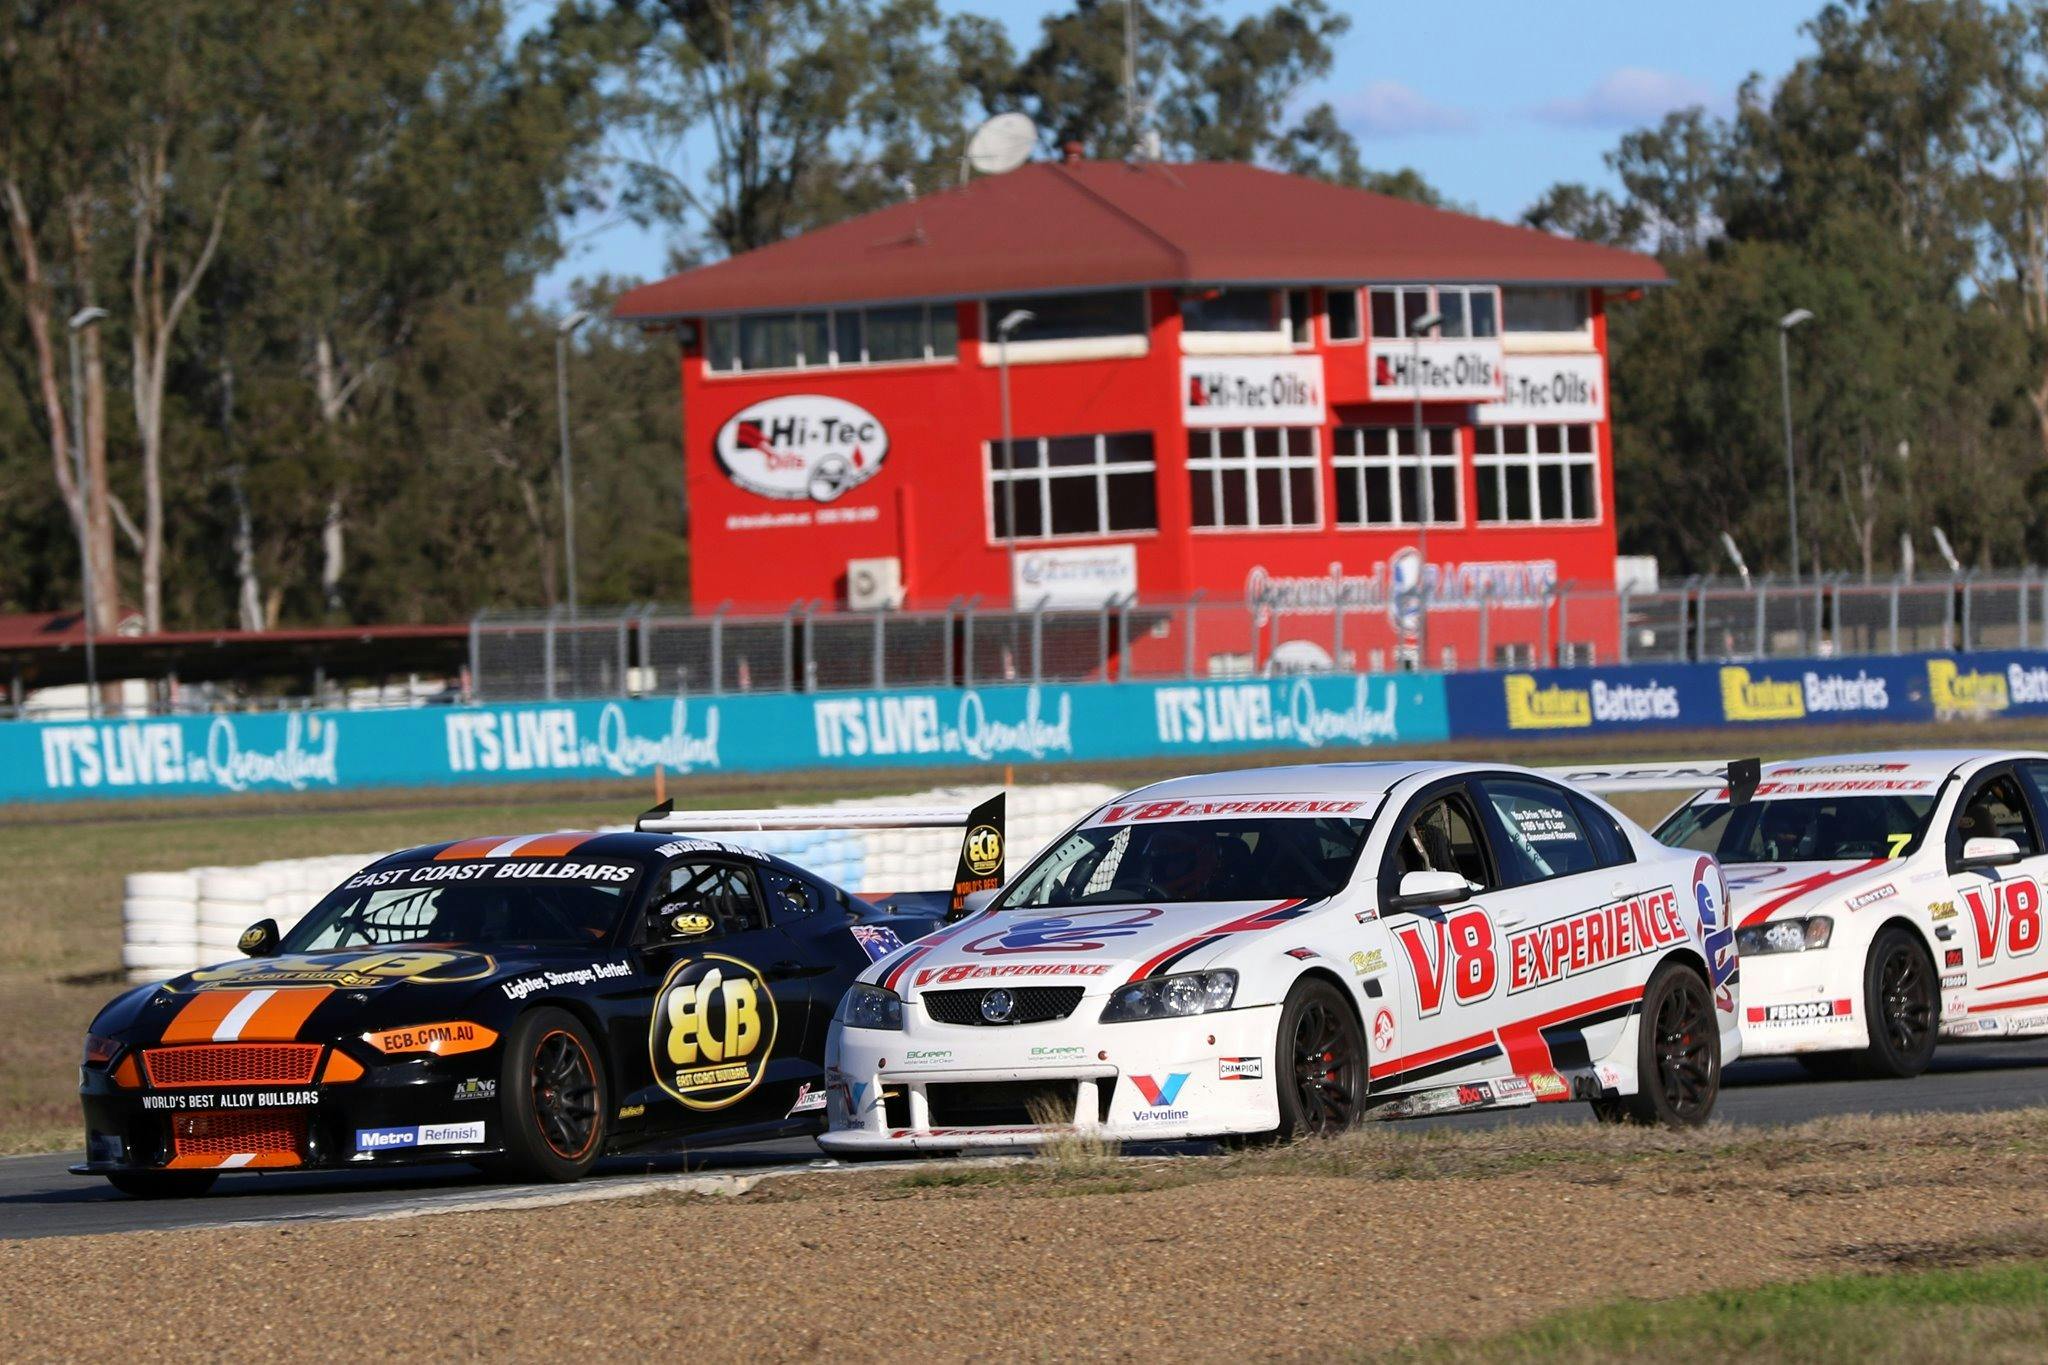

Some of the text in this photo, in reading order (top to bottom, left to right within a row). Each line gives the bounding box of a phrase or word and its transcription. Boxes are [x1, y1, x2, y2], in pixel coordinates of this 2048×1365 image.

[1395, 354, 1490, 386] Hi-Tec Oils
[1209, 372, 1307, 407] Hi-Tec Oils
[1552, 372, 1587, 403] Oils
[771, 416, 875, 446] Hi-Tec
[1591, 679, 1680, 721] Batteries
[1804, 669, 1889, 712] Batteries
[814, 698, 867, 757] IT'S
[867, 695, 941, 754] LIVE!
[959, 685, 1073, 760] Queensland
[1155, 687, 1204, 742] IT'S
[1204, 685, 1274, 742] LIVE!
[1290, 674, 1398, 747] Queensland
[41, 726, 101, 788] IT'S
[101, 723, 185, 785] LIVE!
[207, 713, 338, 791] Queensland
[446, 712, 500, 771] IT'S
[501, 709, 579, 770] LIVE!
[599, 698, 720, 776] Queensland
[1777, 780, 1935, 793] EXPERIENCE
[1100, 800, 1367, 824] V8 EXPERIENCE
[1511, 808, 1563, 820] You Drive This Car
[969, 830, 1000, 861] ECB
[1886, 834, 1913, 858] 7
[345, 862, 636, 890] EAST COAST BULLBARS
[1961, 877, 2042, 966] V8
[1509, 888, 1688, 992] EXPERIENCE
[914, 964, 1114, 988] V8 EXPERIENCE
[1392, 907, 1498, 1018] V8
[501, 960, 633, 999] Lighter, Stronger, Better!
[667, 967, 761, 1065] ECB
[1769, 1002, 1830, 1020] FERODO
[383, 1026, 474, 1051] ECB.COM.AU
[676, 1066, 750, 1087] EAST COAST BULLBARS
[1220, 1064, 1260, 1073] CHAMPION
[142, 1091, 319, 1109] WORLD'S BEST ALLOY BULLBARS
[1133, 1109, 1189, 1121] Valvoline
[361, 1127, 478, 1147] Metro Refinish
